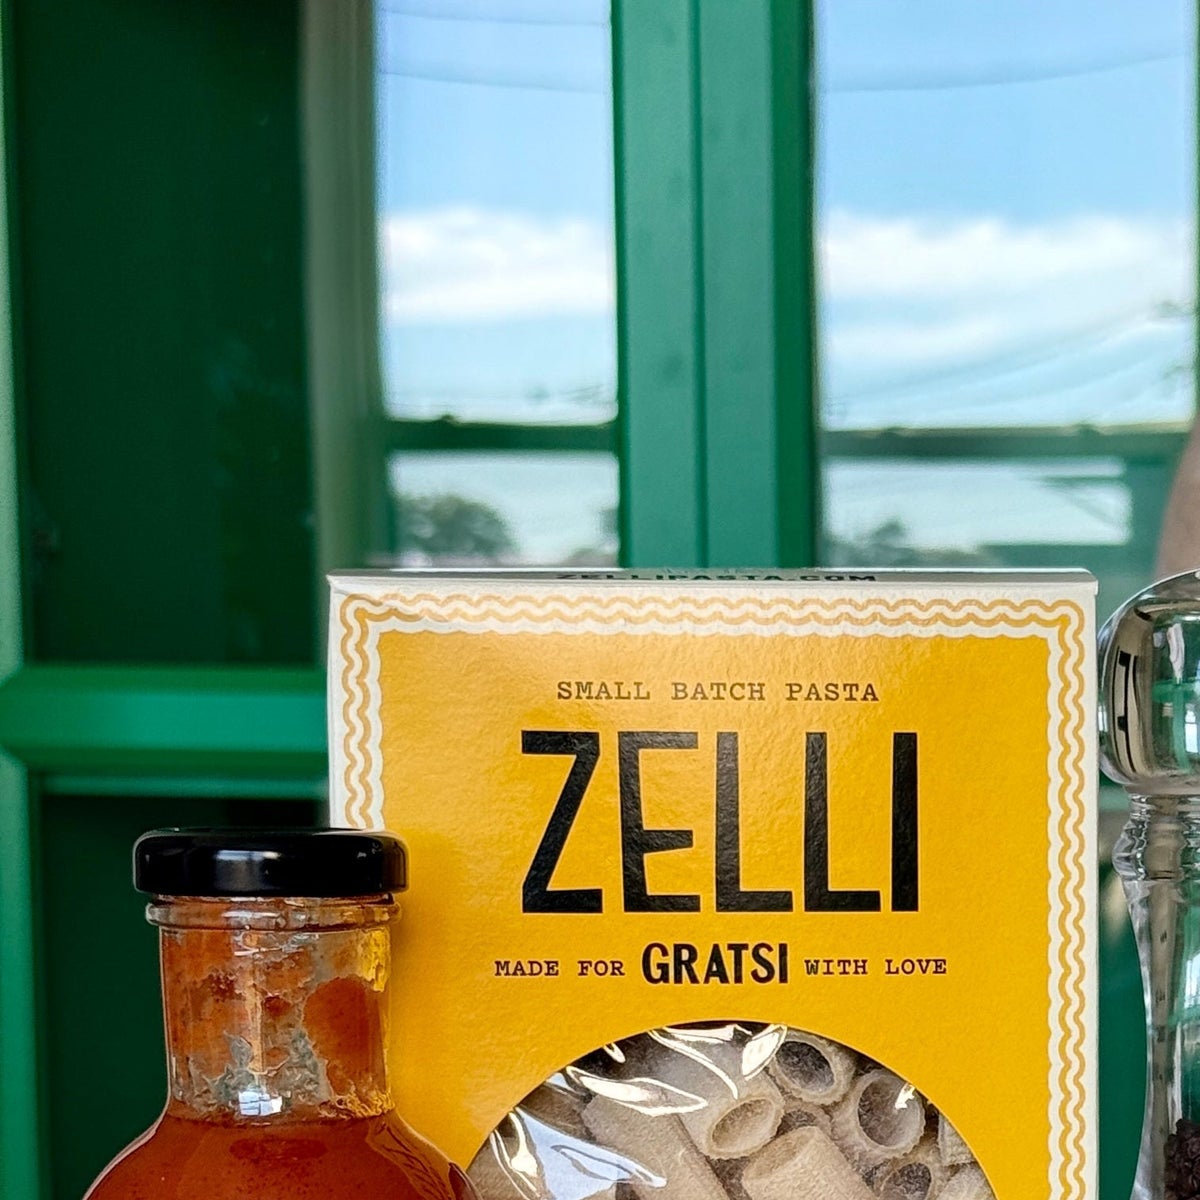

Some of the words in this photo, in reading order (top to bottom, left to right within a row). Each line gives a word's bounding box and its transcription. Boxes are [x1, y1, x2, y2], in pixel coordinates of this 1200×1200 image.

[556, 573, 877, 582] ZELLIPASTA.COM
[556, 680, 651, 701] SMALL
[670, 682, 766, 702] BATCH
[784, 682, 880, 702] PASTA
[520, 729, 919, 914] ZELLI
[494, 960, 559, 977] MADE
[577, 959, 626, 977] FOR
[641, 942, 789, 985] GRATSI
[803, 959, 868, 976] WITH
[884, 958, 947, 975] LOVE
